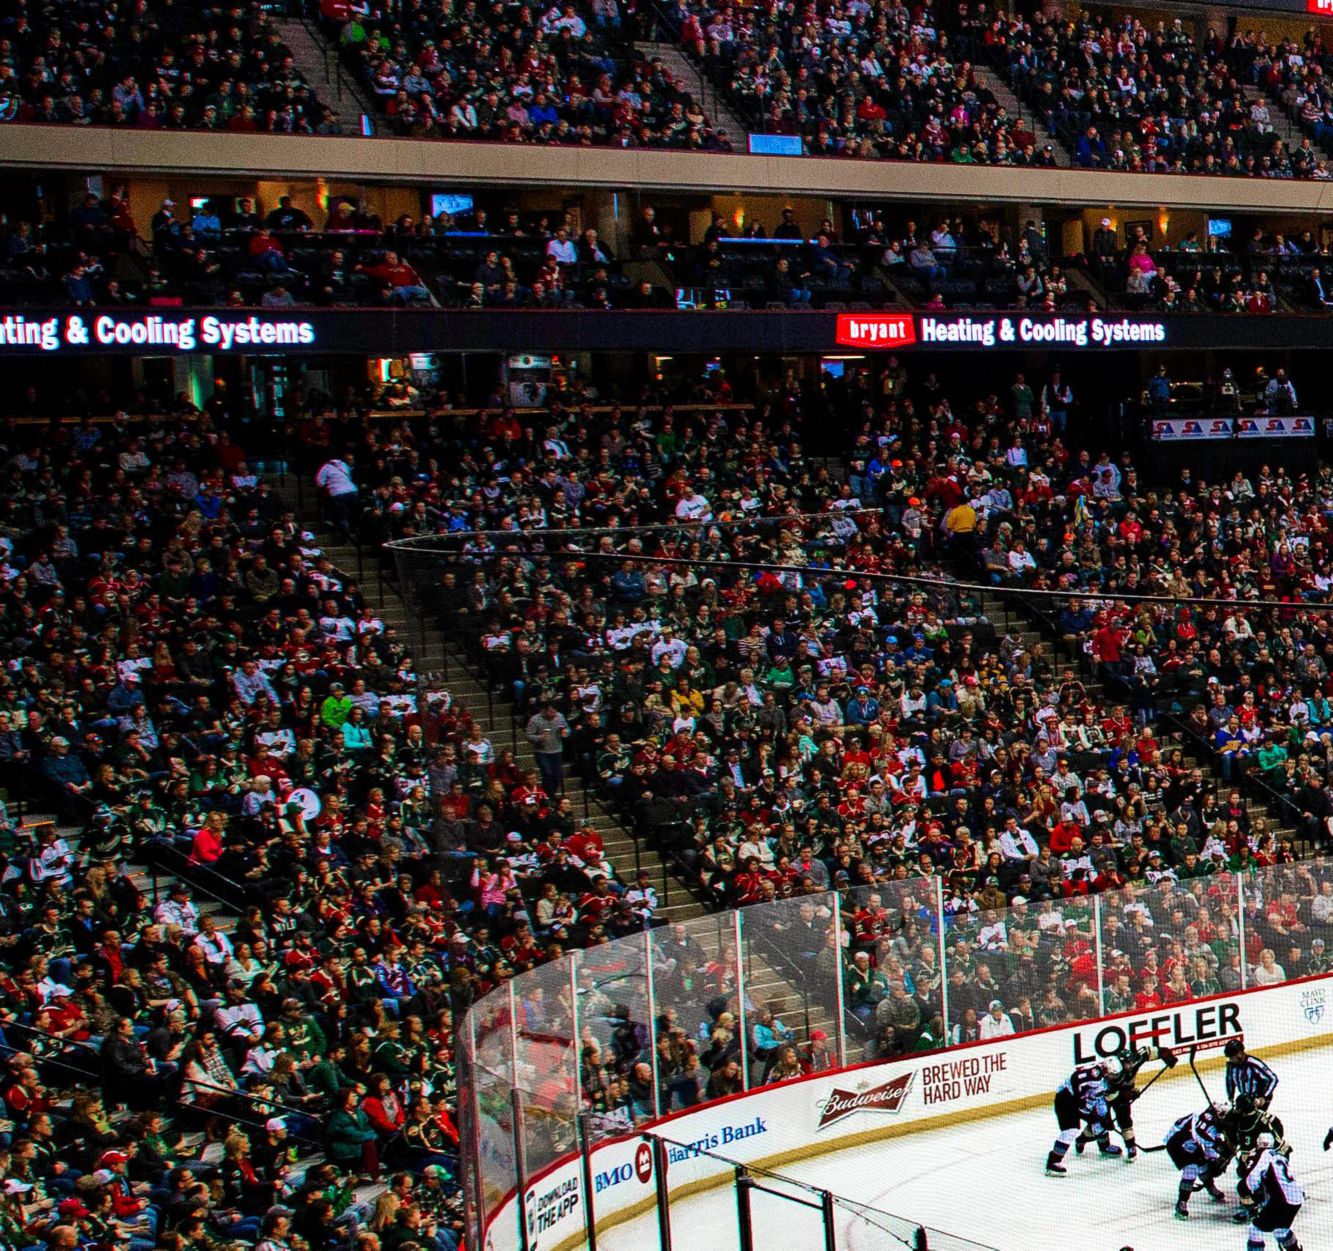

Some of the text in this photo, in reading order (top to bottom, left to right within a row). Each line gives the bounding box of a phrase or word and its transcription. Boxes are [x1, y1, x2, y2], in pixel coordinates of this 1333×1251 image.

[65, 316, 89, 344] &
[95, 316, 196, 350] Cooling
[201, 317, 314, 349] Systems
[850, 318, 1165, 346] bryant Heating & Cooling Systems
[1072, 1002, 1243, 1065] LOFFLER
[922, 1052, 1007, 1085] BREWED THE
[816, 1081, 913, 1115] Budweiser
[923, 1074, 991, 1105] HARD WAY
[595, 1117, 768, 1194] BMO Harris Bank
[537, 1177, 578, 1212] DOWNLOAD
[537, 1194, 579, 1234] THE APP
